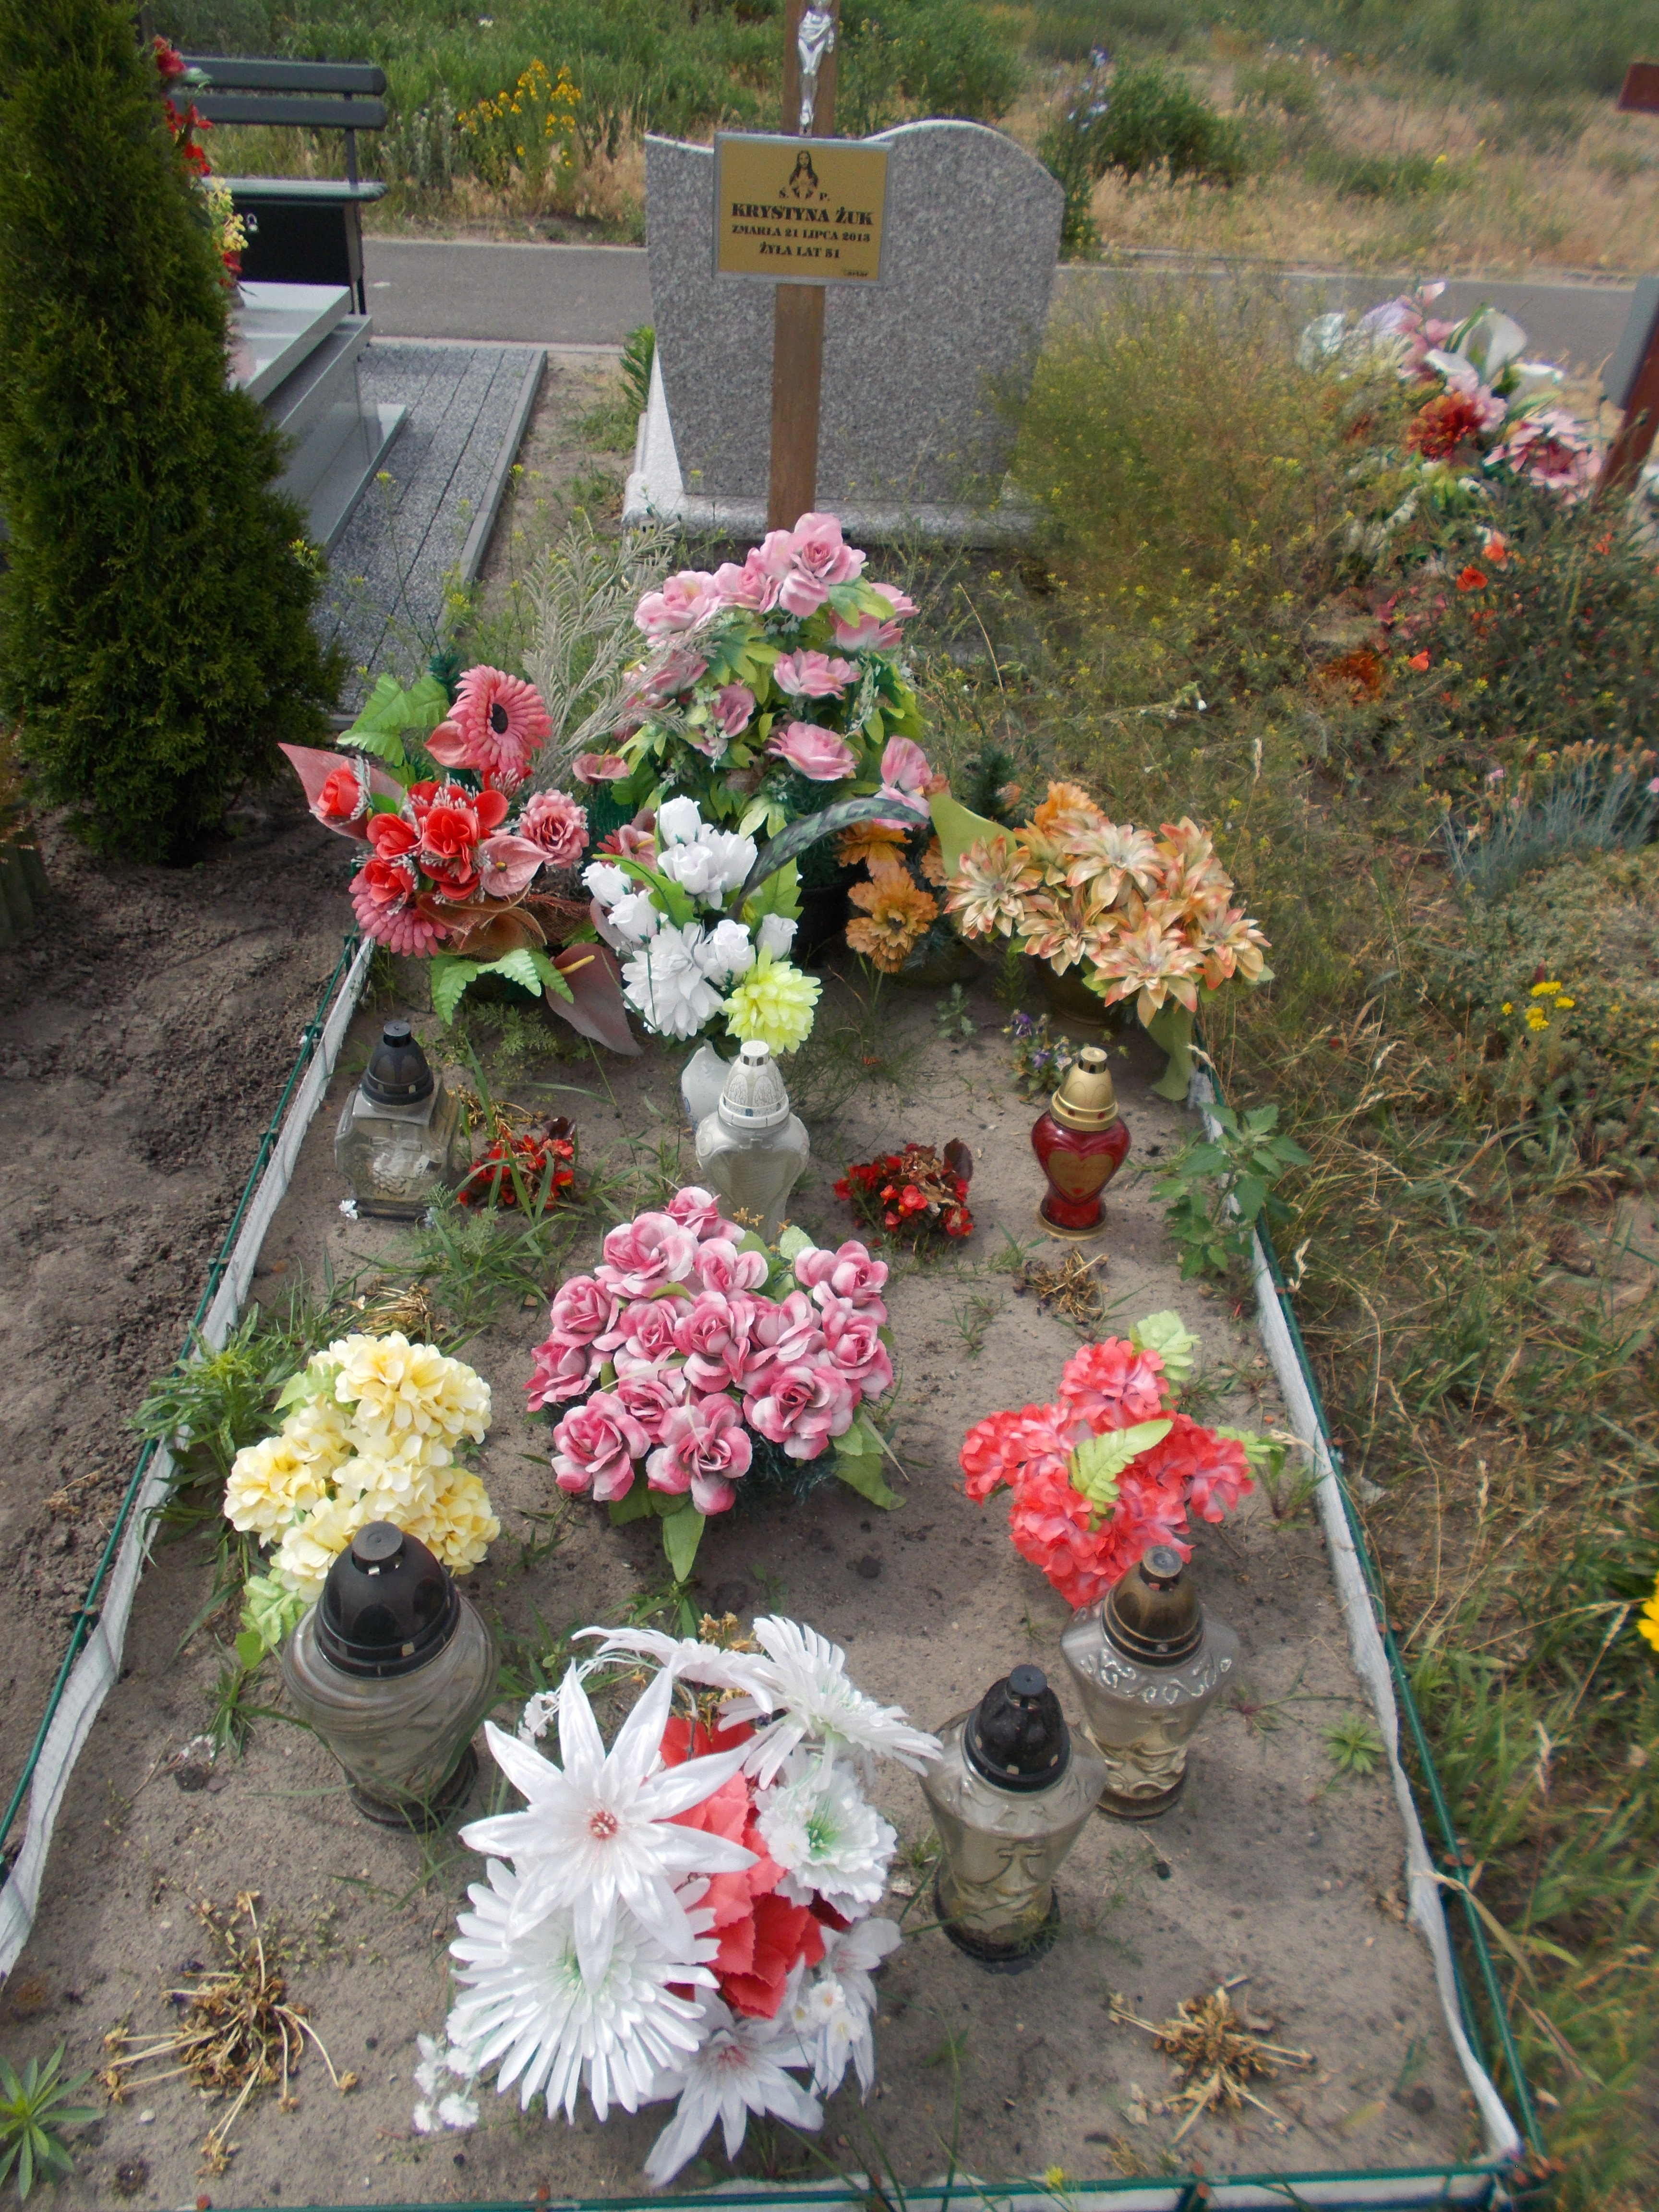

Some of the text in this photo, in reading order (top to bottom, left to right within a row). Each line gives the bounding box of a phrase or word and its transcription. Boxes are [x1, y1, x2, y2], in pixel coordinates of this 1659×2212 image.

[732, 203, 873, 225] KRYSTYNA ŻUK
[785, 228, 798, 237] 21
[803, 229, 838, 240] LIPCA
[796, 246, 821, 257] LAT
[825, 248, 840, 258] 51
